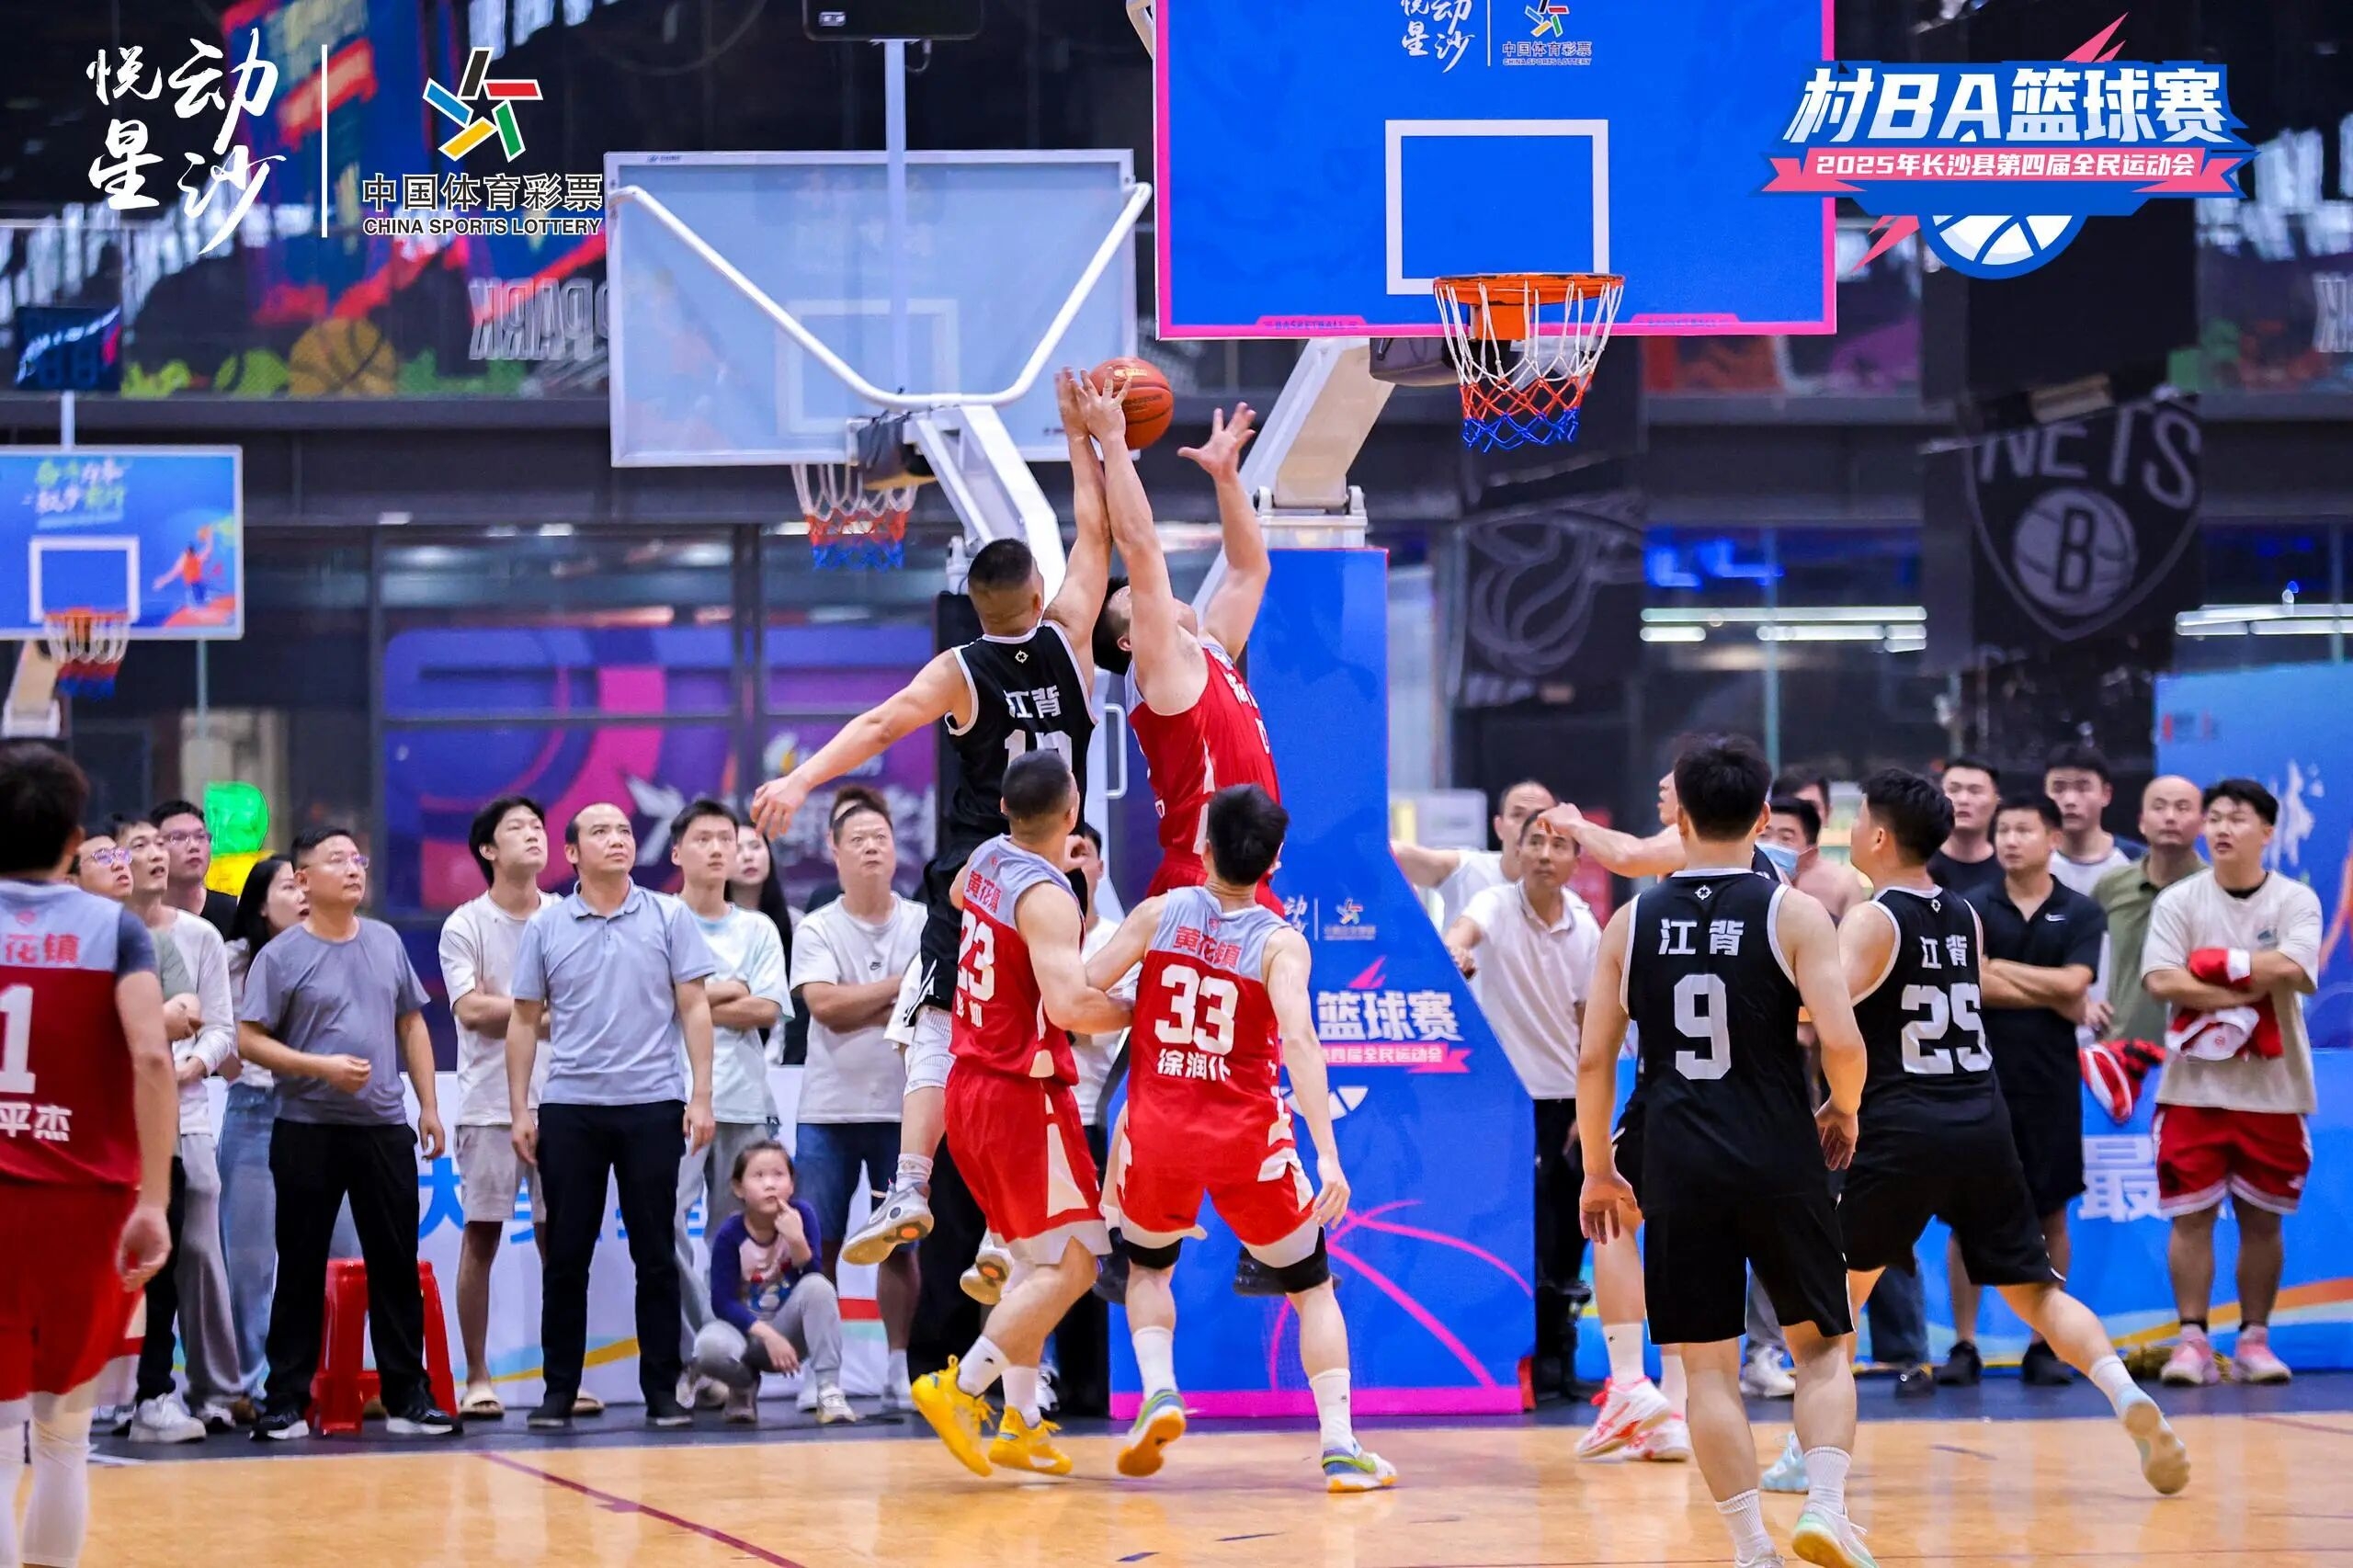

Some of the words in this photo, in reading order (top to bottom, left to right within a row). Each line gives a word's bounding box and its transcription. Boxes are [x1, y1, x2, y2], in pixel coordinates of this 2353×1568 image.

[1502, 40, 1593, 57] 中国体育彩票
[1503, 58, 1527, 66] CHINA
[1528, 58, 1557, 66] SPORTS
[1558, 58, 1593, 66] LOTTERY
[1004, 685, 1062, 719] 江背
[957, 907, 995, 1002] 23
[1173, 926, 1243, 970] 黄花镇
[1658, 917, 1745, 956] 江背
[1920, 935, 1968, 970] 江背
[1154, 963, 1239, 1057] 33
[1316, 990, 1465, 1042] 篮球赛
[1673, 973, 1732, 1081] 9
[1900, 983, 1994, 1075] 25
